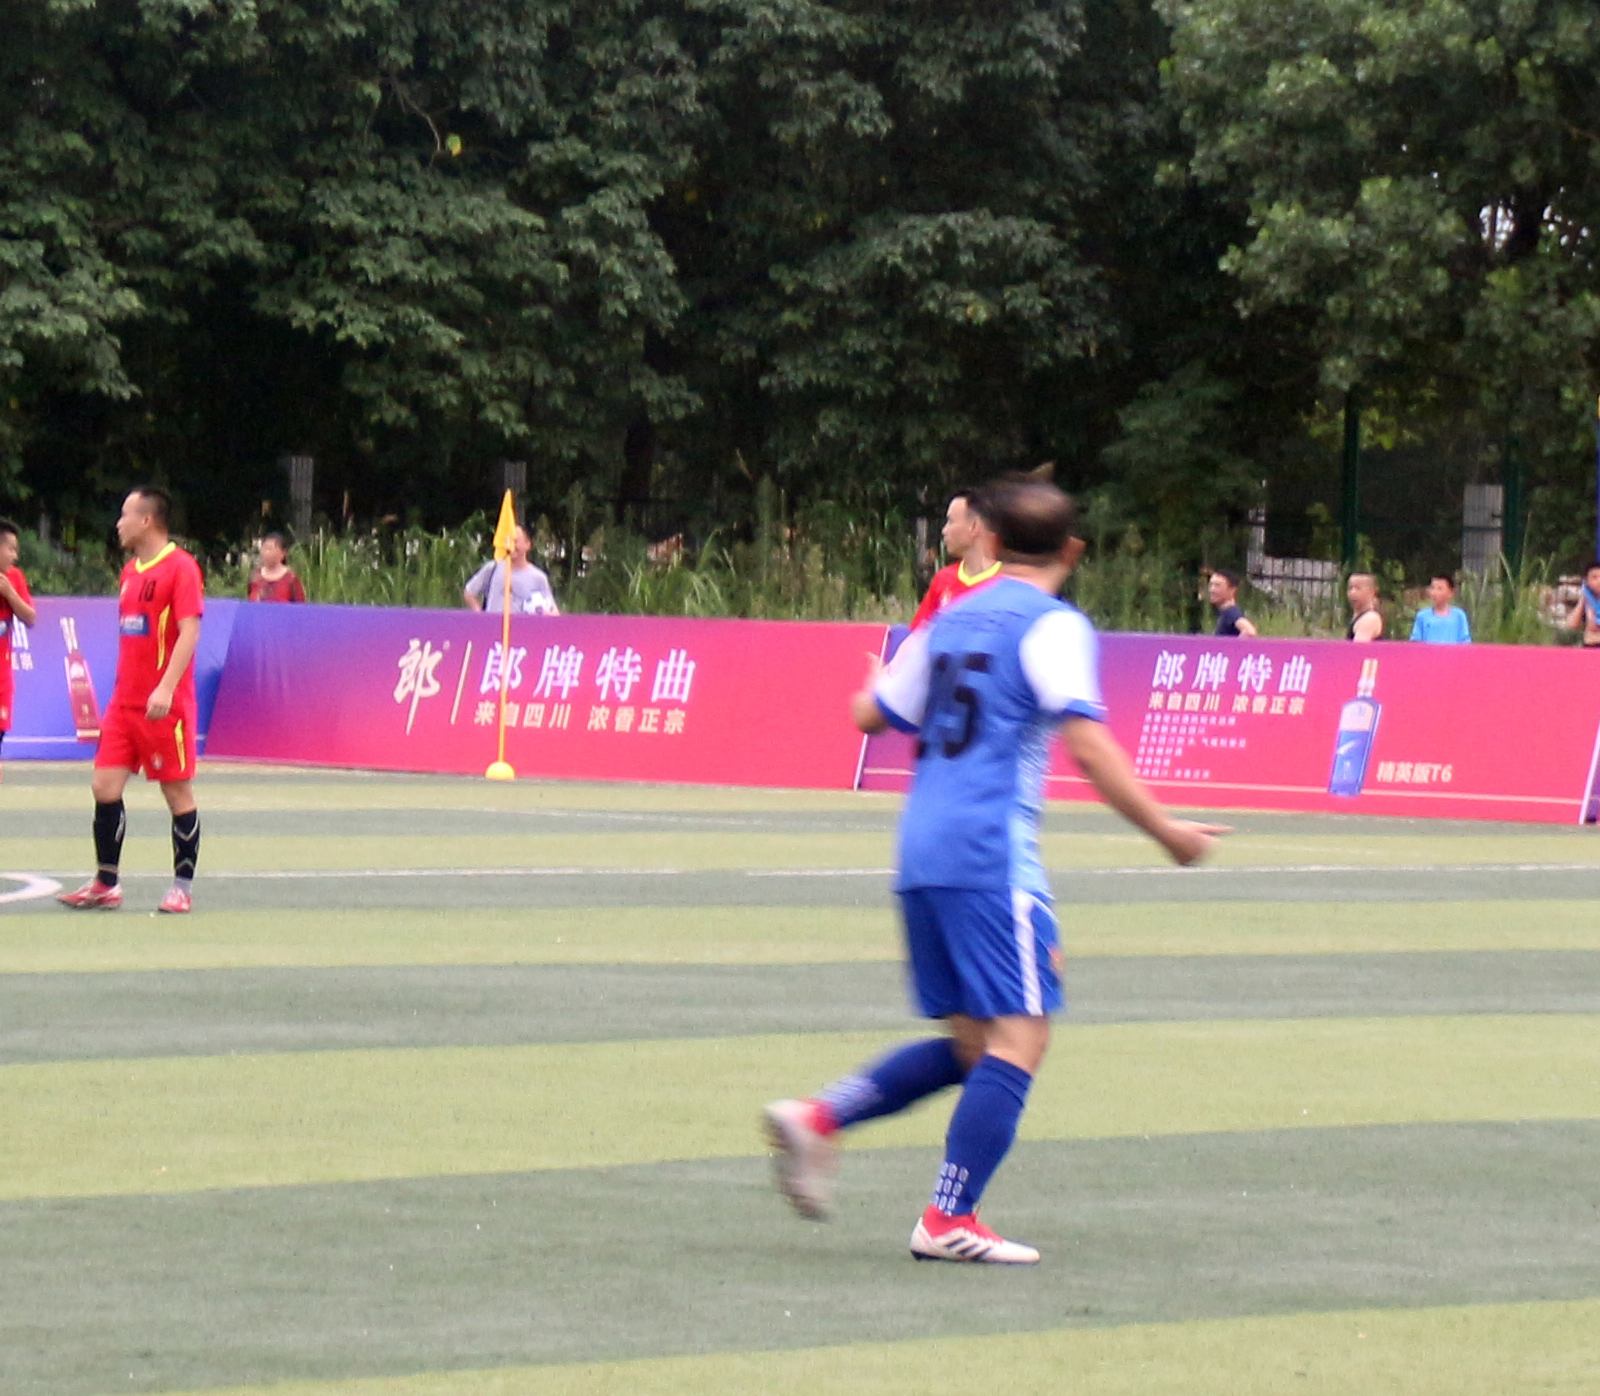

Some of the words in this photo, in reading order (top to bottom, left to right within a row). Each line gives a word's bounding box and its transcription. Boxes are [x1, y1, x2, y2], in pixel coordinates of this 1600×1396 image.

[479, 640, 697, 704] 郎牌特曲
[1151, 650, 1313, 694] 郎牌特曲
[473, 699, 572, 730] 来自四川
[587, 703, 687, 735] 浓香正宗
[1148, 690, 1221, 712] 来自四川
[1231, 693, 1306, 716] 浓香正宗
